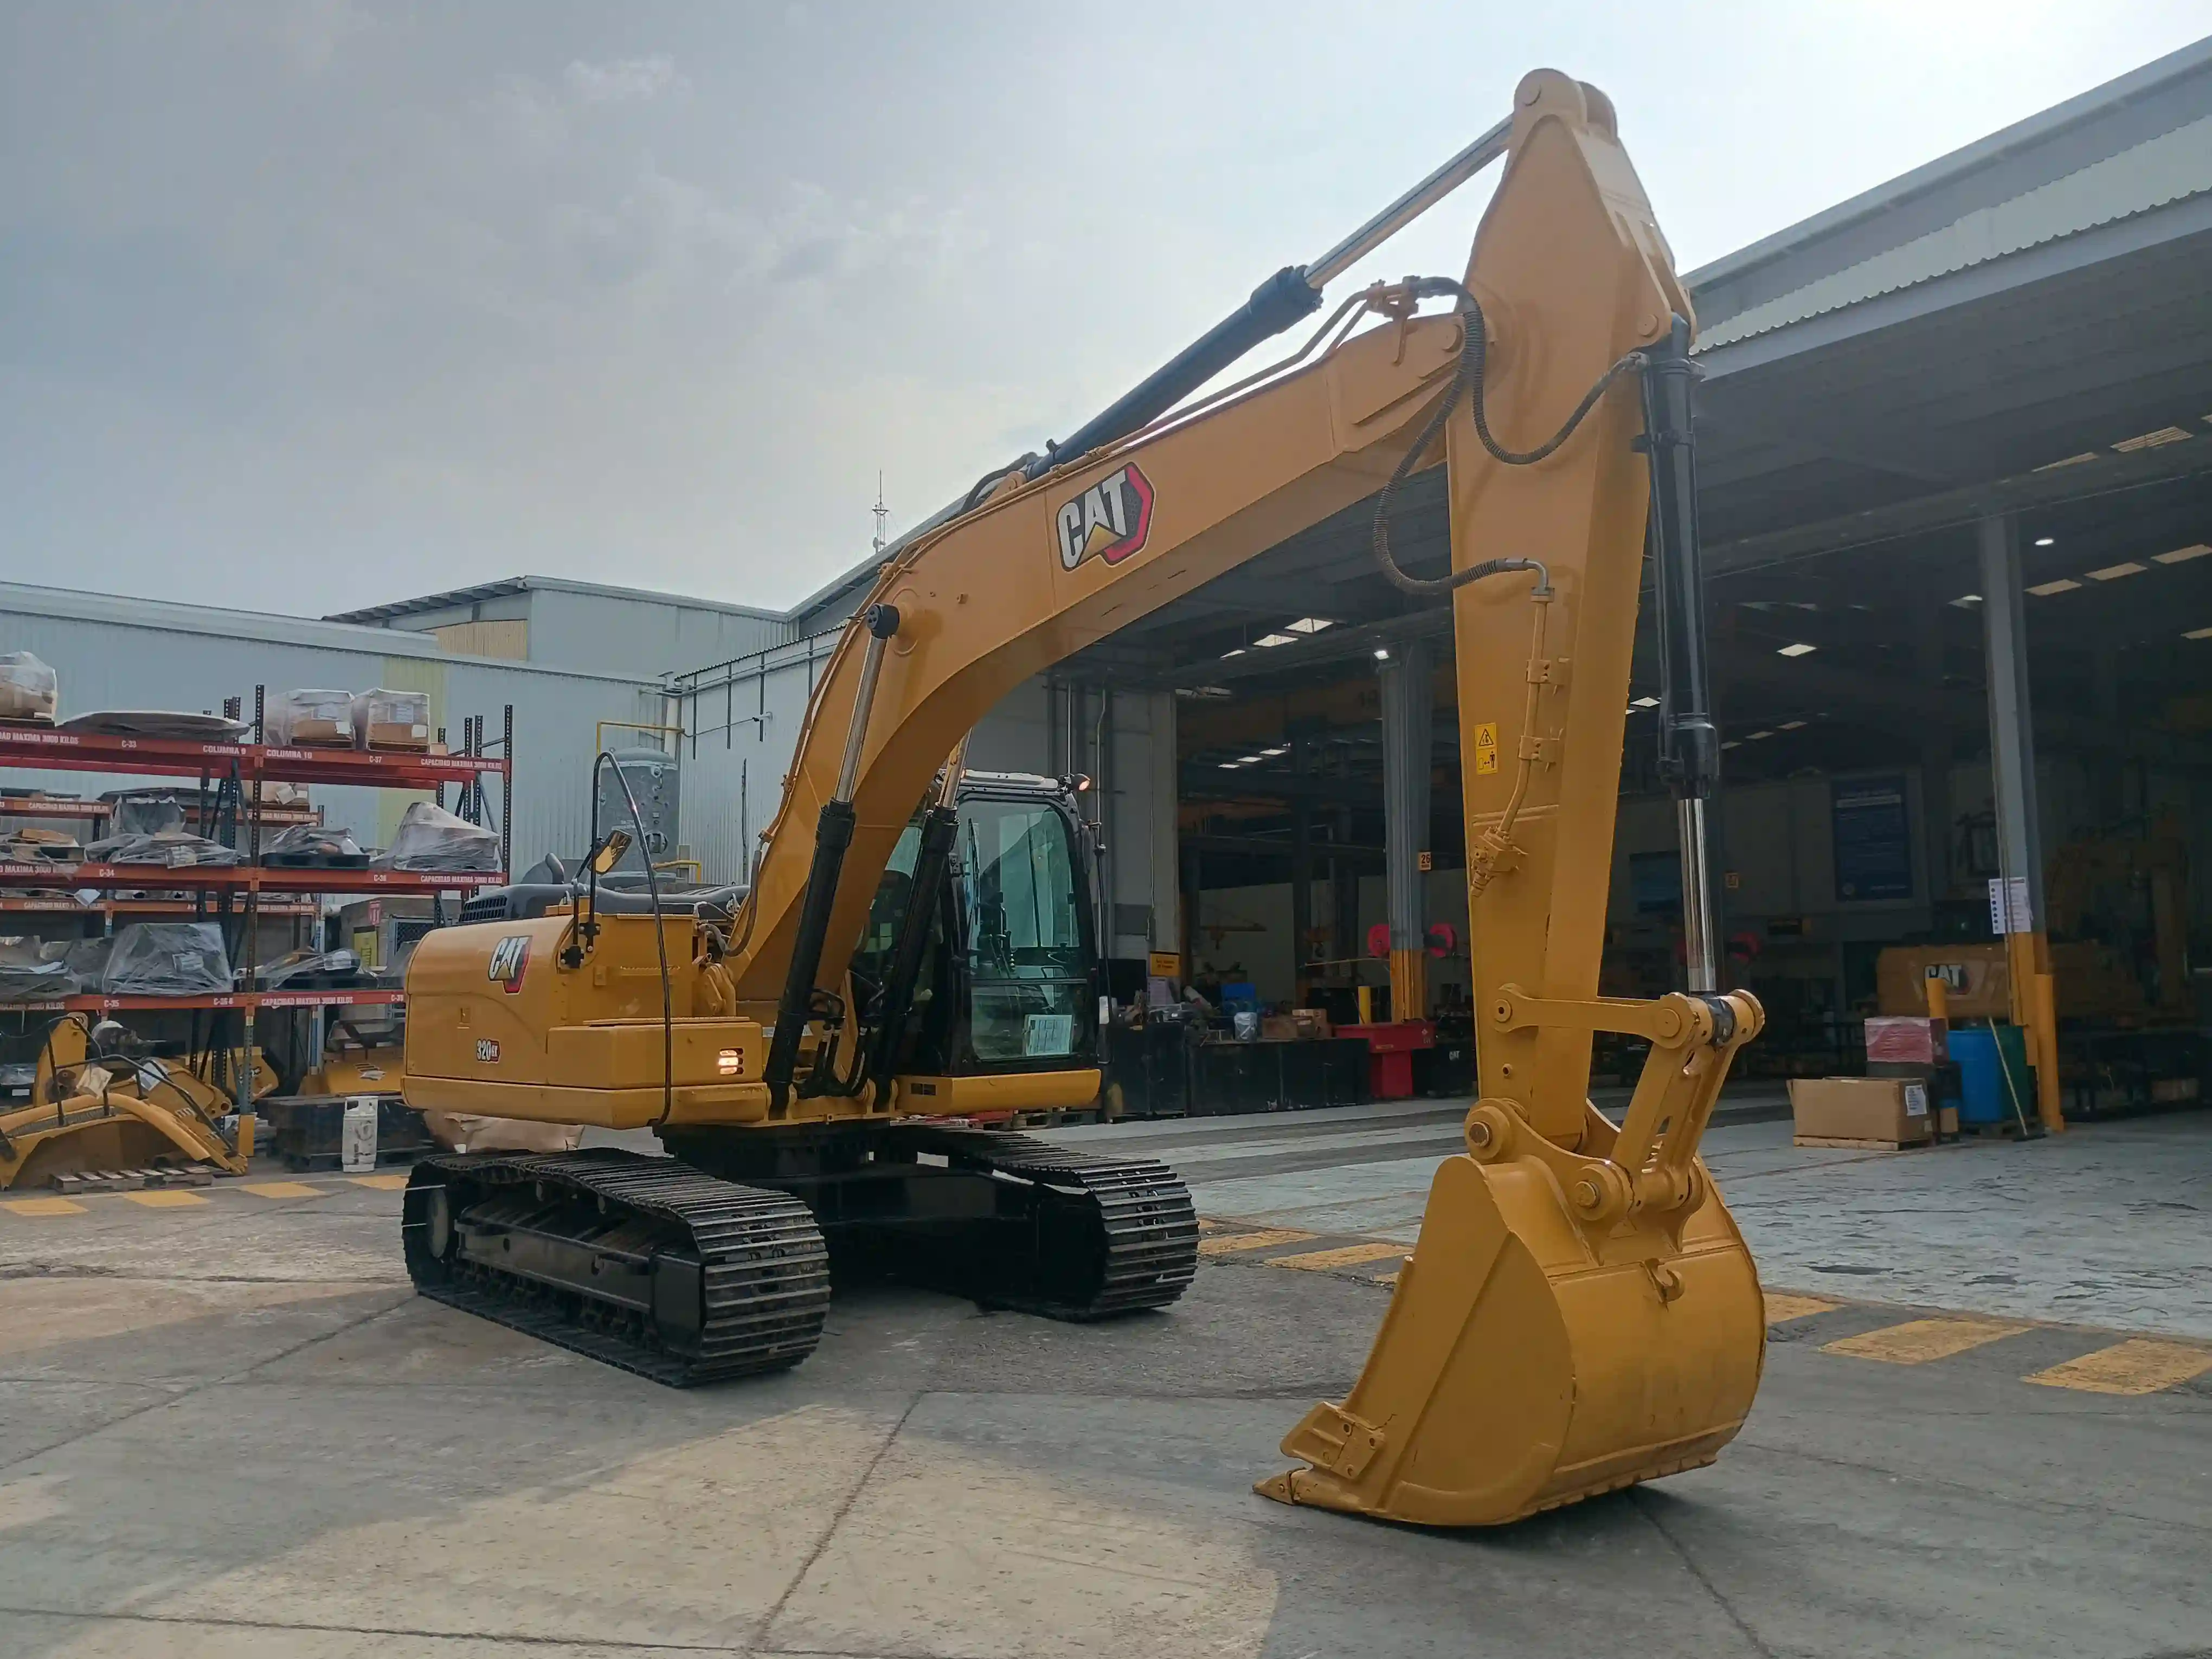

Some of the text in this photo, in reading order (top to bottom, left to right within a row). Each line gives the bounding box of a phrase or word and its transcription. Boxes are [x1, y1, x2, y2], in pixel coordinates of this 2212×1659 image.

[1058, 468, 1127, 568] CAT
[12, 732, 41, 742] MAXIMA
[42, 735, 59, 743] 3000
[60, 736, 79, 744] KILOS
[203, 745, 240, 754] COLUMNA
[266, 749, 301, 758] COLUMNA
[369, 755, 382, 763] C-37
[421, 758, 451, 767] CAPACIDAD
[1421, 854, 1430, 864] 26
[5, 865, 34, 873] MAXIMA
[35, 866, 52, 874] 3000
[99, 869, 114, 877] C-34
[421, 875, 451, 883] CAPACIDAD
[489, 936, 530, 980] CAT
[1925, 964, 1962, 988] CAT
[104, 1000, 119, 1008] C-35
[261, 998, 294, 1006] CAPACIDAD
[477, 1040, 491, 1060] 320
[1449, 1051, 1460, 1060] CAT
